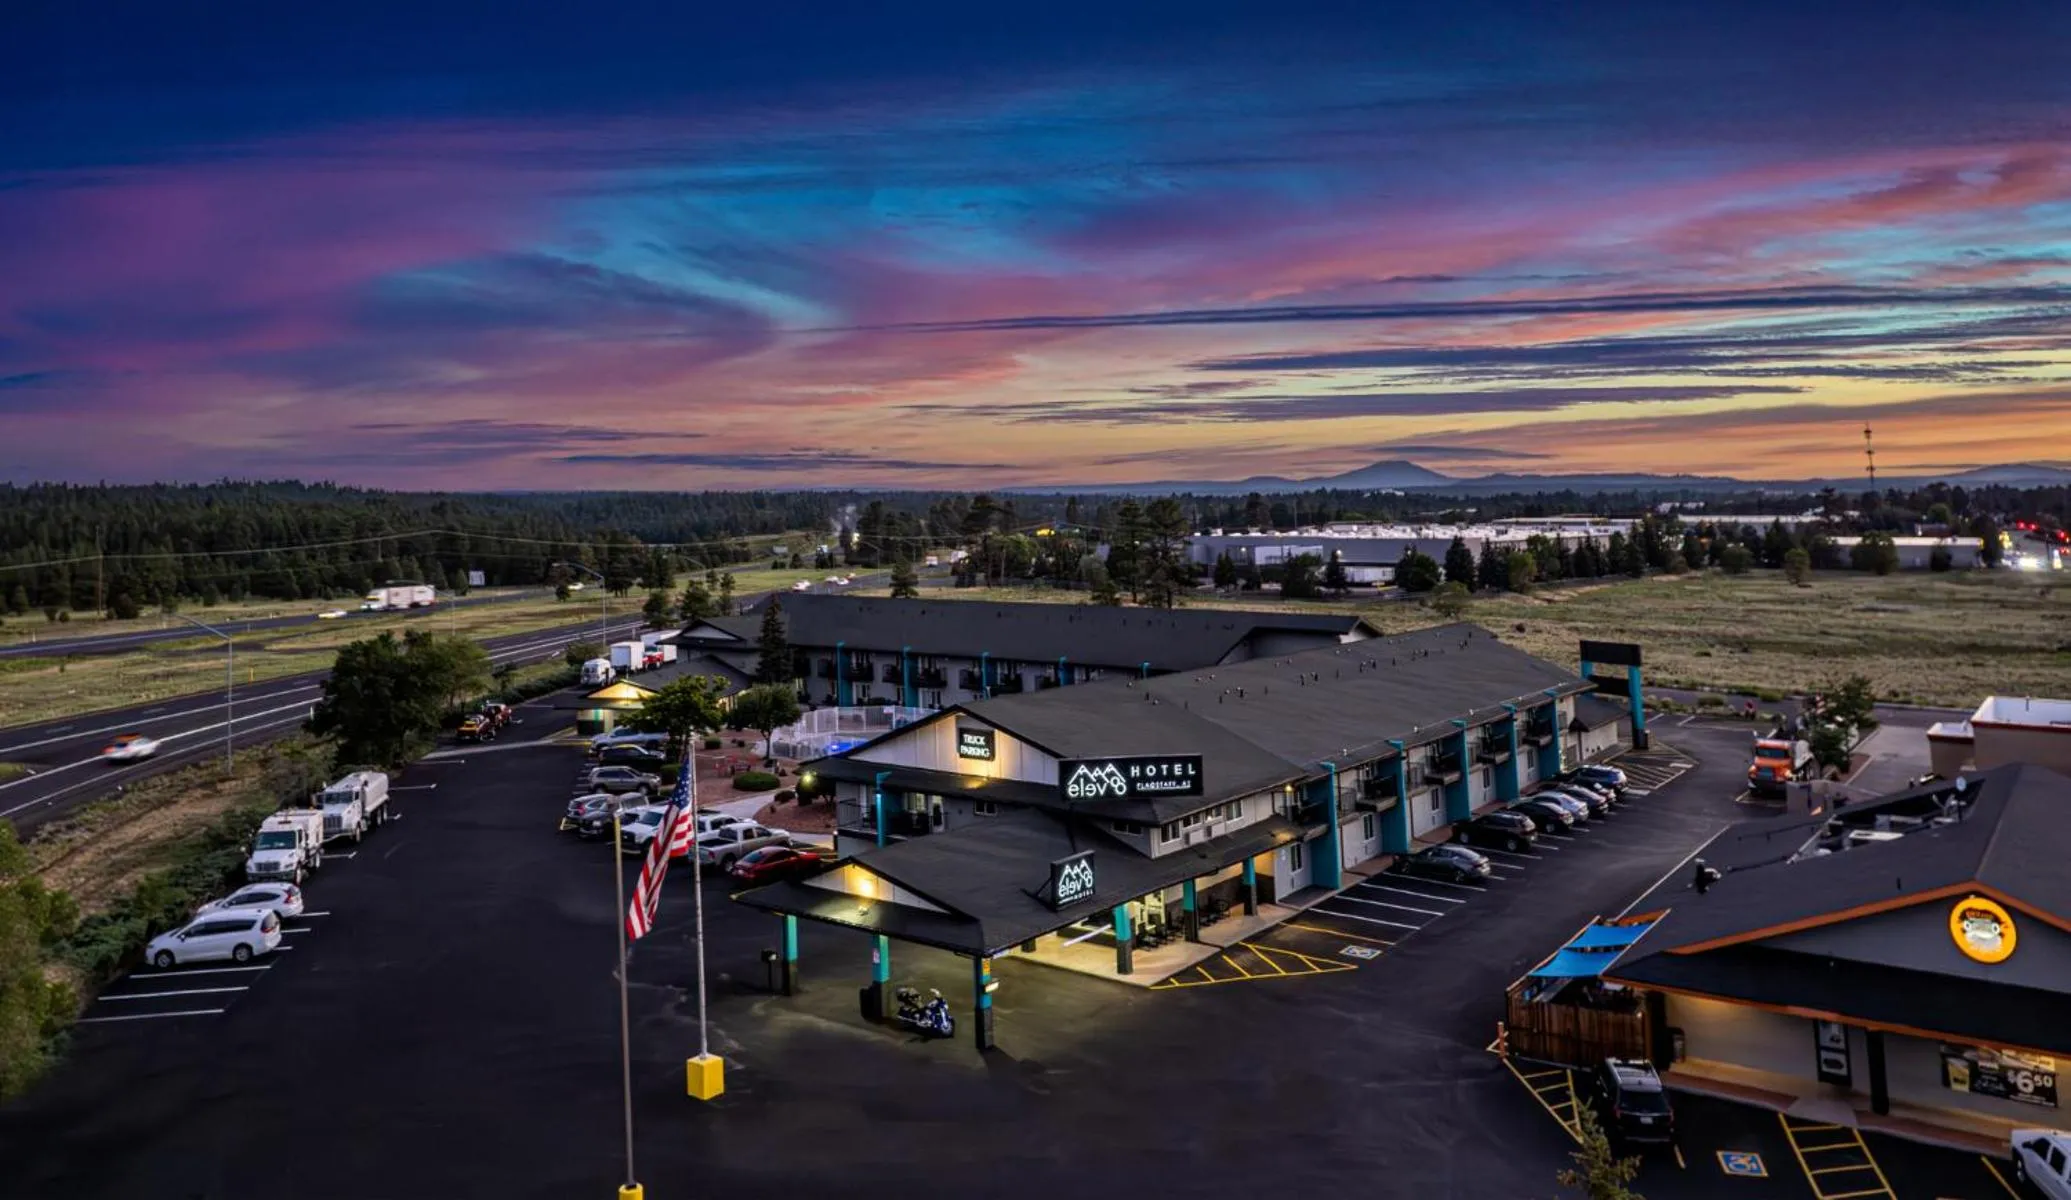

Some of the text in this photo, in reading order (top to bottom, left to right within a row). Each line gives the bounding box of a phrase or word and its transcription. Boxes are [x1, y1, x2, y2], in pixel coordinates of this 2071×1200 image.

[963, 733, 985, 745] TRUCK
[961, 744, 989, 757] PARKING
[1131, 763, 1196, 778] HOTEL
